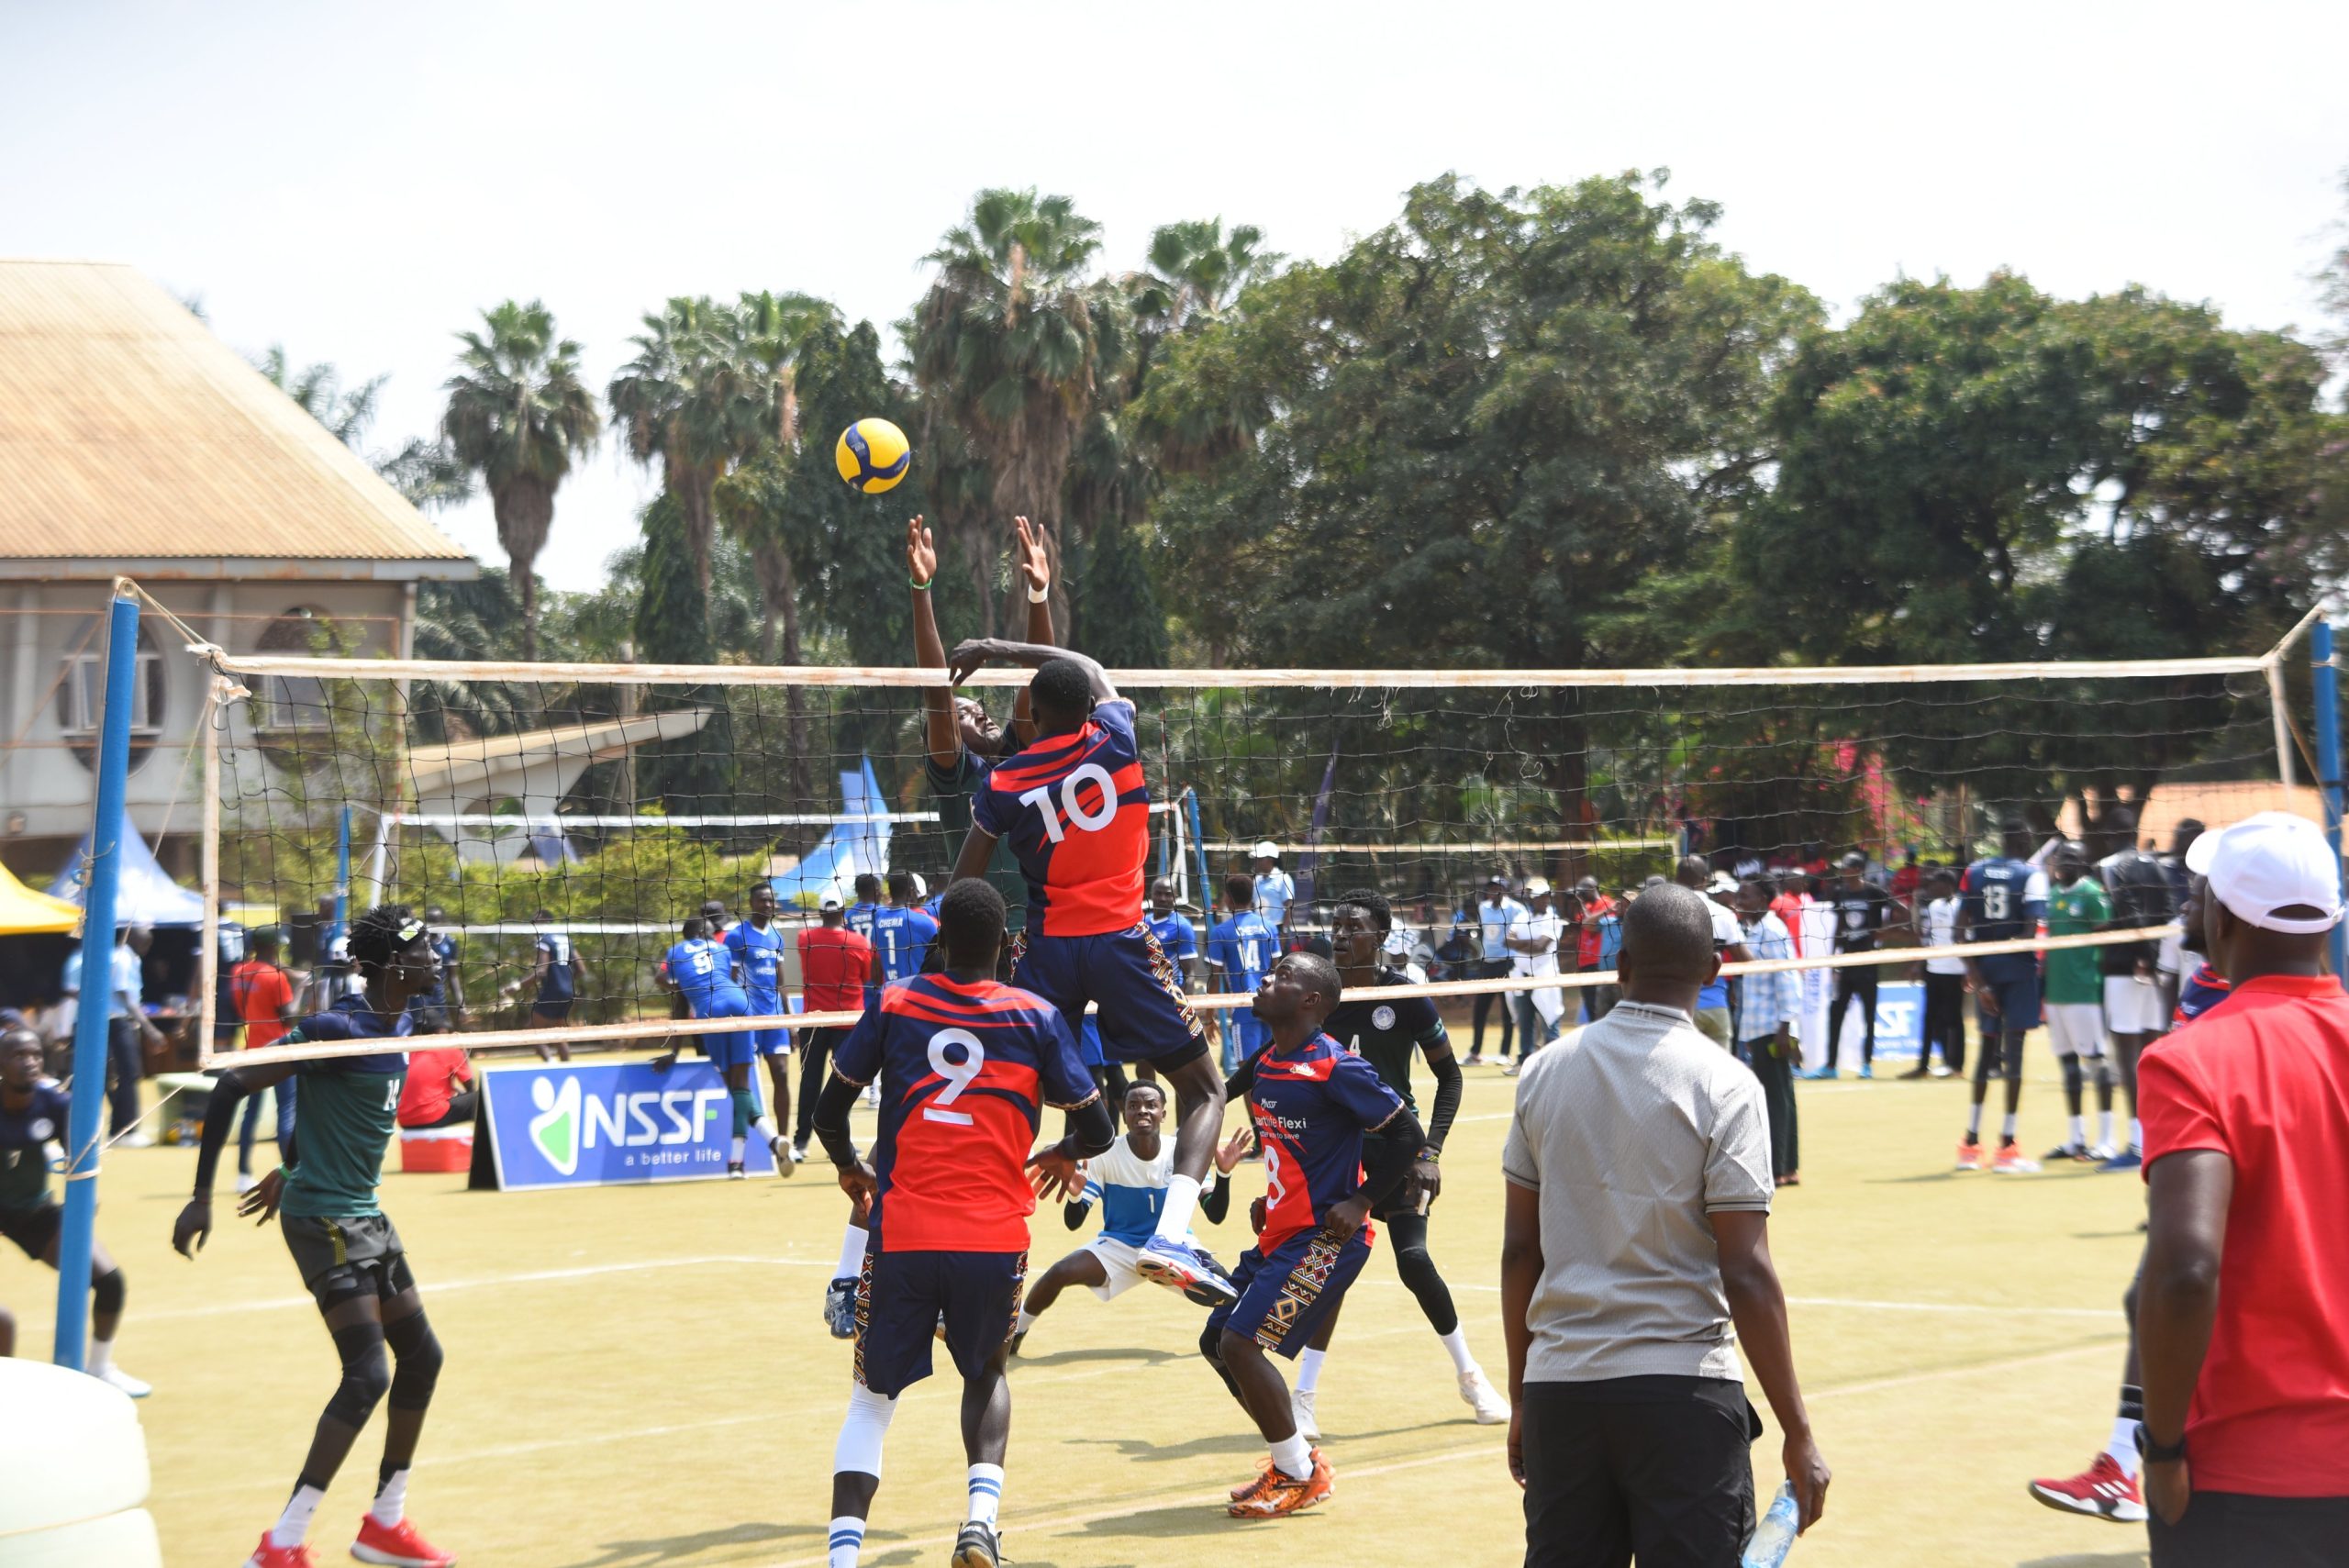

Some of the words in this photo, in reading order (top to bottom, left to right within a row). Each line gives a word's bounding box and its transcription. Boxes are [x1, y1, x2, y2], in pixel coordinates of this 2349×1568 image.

[1019, 763, 1118, 843] 10
[1982, 884, 2011, 919] 13
[852, 923, 874, 950] 17
[878, 917, 904, 929] CHEMA
[885, 929, 896, 965] 1
[1237, 940, 1262, 973] 14
[692, 951, 715, 975] 9
[1349, 1034, 1362, 1057] 4
[926, 1028, 985, 1106] 9
[583, 1089, 728, 1149] NSSF
[1277, 1116, 1307, 1129] Flexi
[624, 1154, 635, 1166] a
[640, 1151, 689, 1166] better
[696, 1149, 722, 1162] life
[1264, 1145, 1286, 1210] 8
[1148, 1194, 1155, 1214] 1
